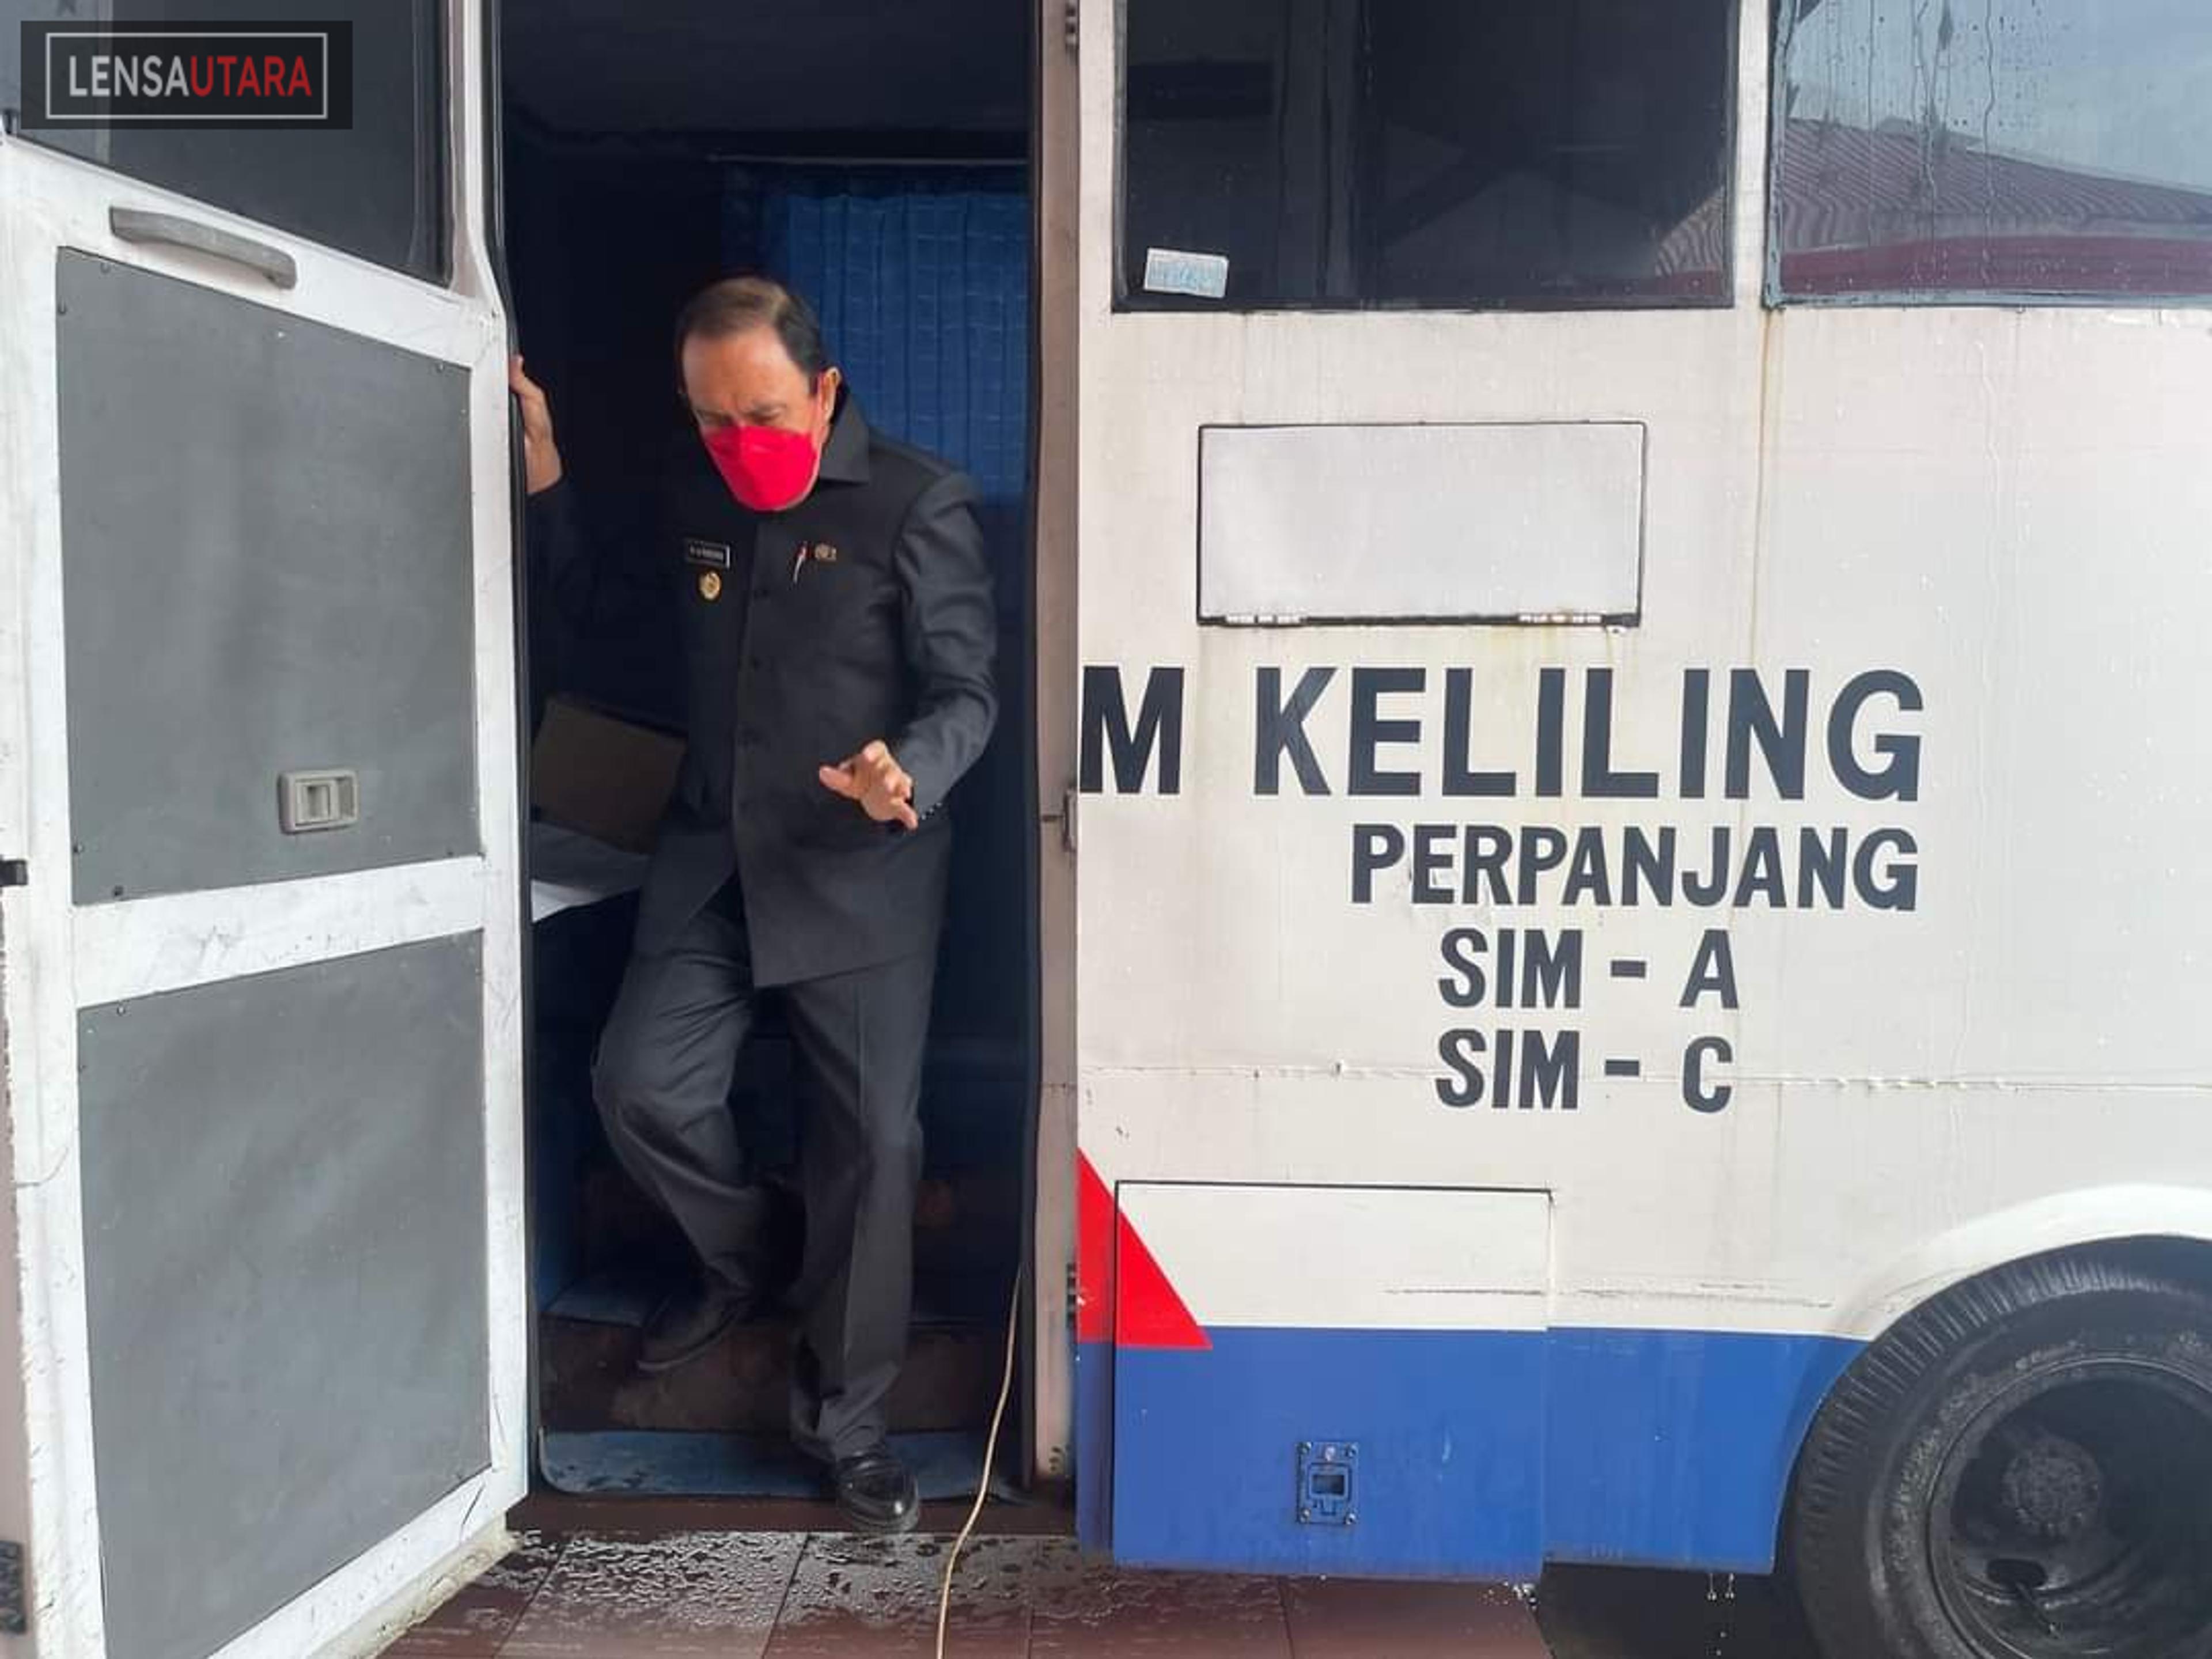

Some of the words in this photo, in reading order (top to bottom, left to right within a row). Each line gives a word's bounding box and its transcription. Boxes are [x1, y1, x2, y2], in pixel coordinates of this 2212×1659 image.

[1080, 665, 1185, 795] M
[1254, 667, 1923, 801] KELILING
[1352, 824, 1918, 911] PERPANJANG
[1438, 928, 1582, 1009] SIM
[1611, 960, 1646, 978] -
[1680, 929, 1738, 1009] A
[1435, 1029, 1580, 1109] SIM
[1605, 1059, 1640, 1077] -
[1683, 1036, 1732, 1113] C
